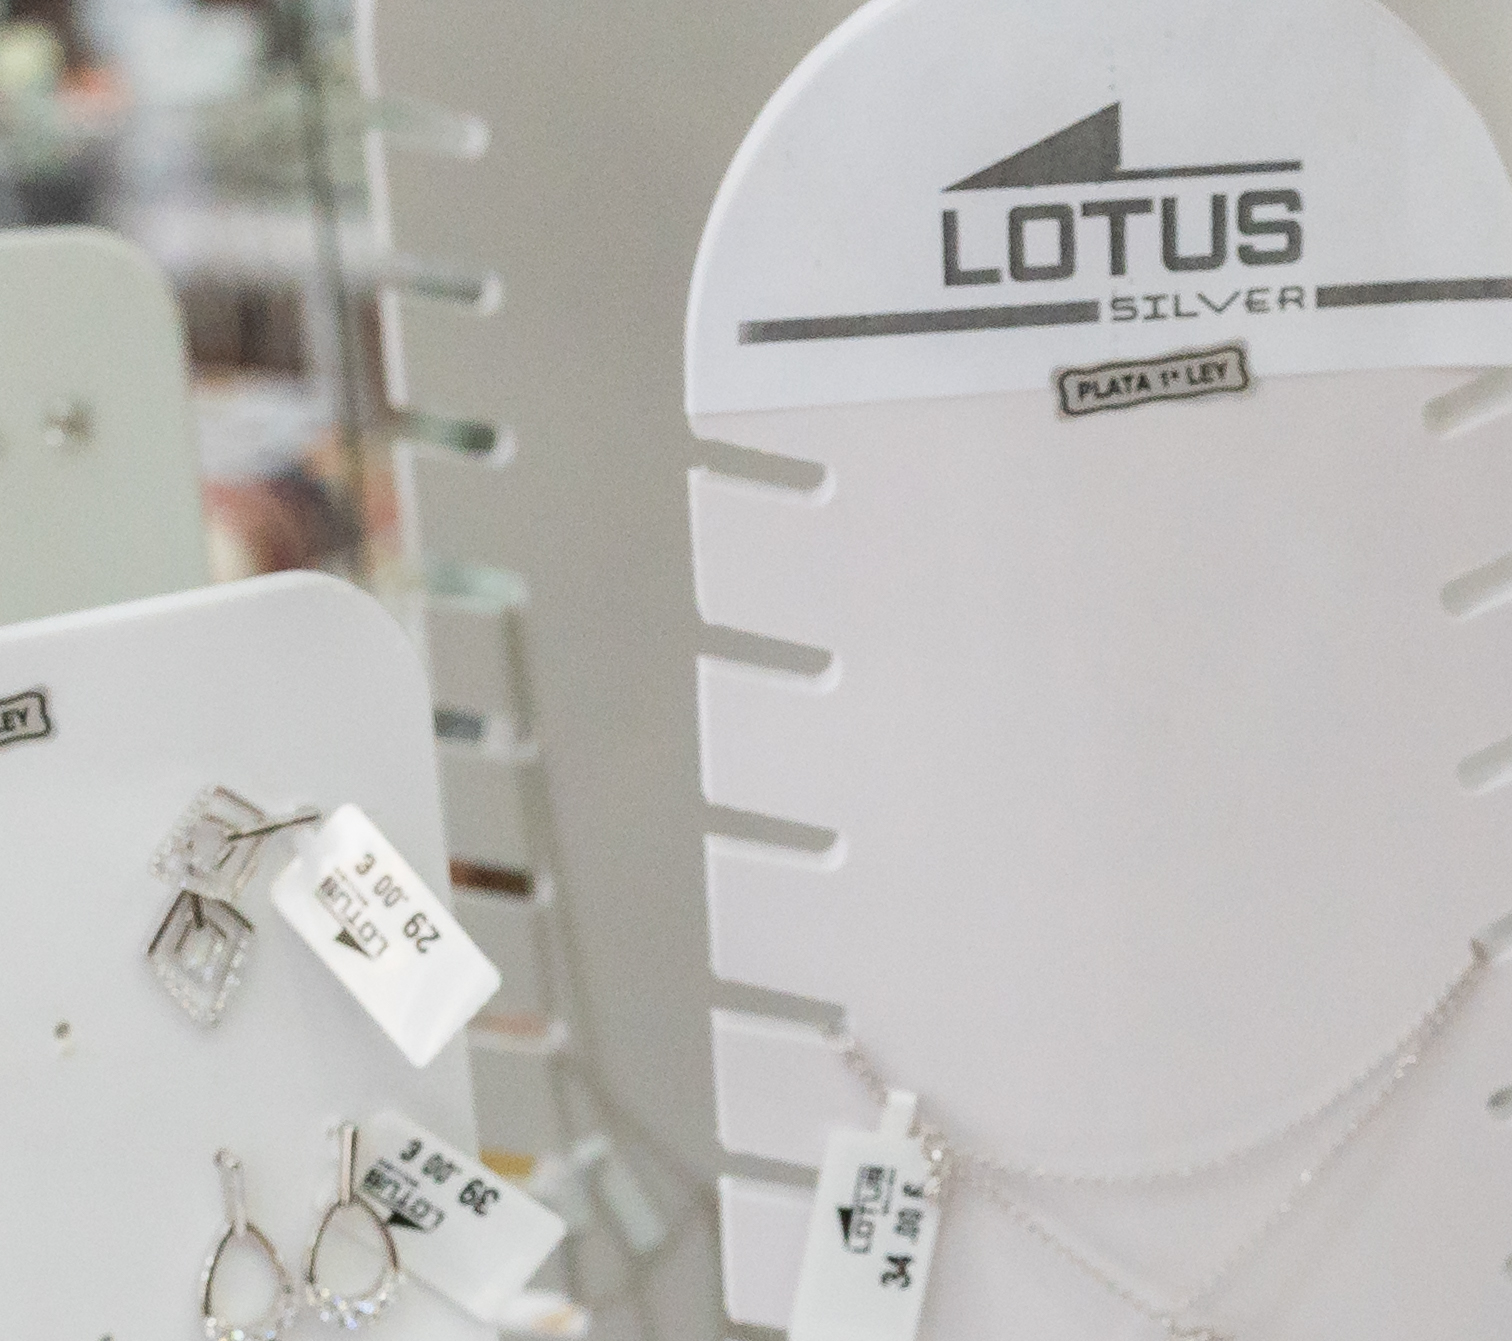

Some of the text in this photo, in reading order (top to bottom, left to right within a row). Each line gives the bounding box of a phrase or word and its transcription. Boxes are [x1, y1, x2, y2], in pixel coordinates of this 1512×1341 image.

[942, 187, 1303, 286] LOTUS
[1110, 286, 1305, 322] SILVER
[1076, 374, 1151, 401] PLATA
[1188, 361, 1229, 386] LEY
[402, 911, 441, 954] 29
[458, 1178, 500, 1216] 39
[879, 1253, 912, 1290] 34
